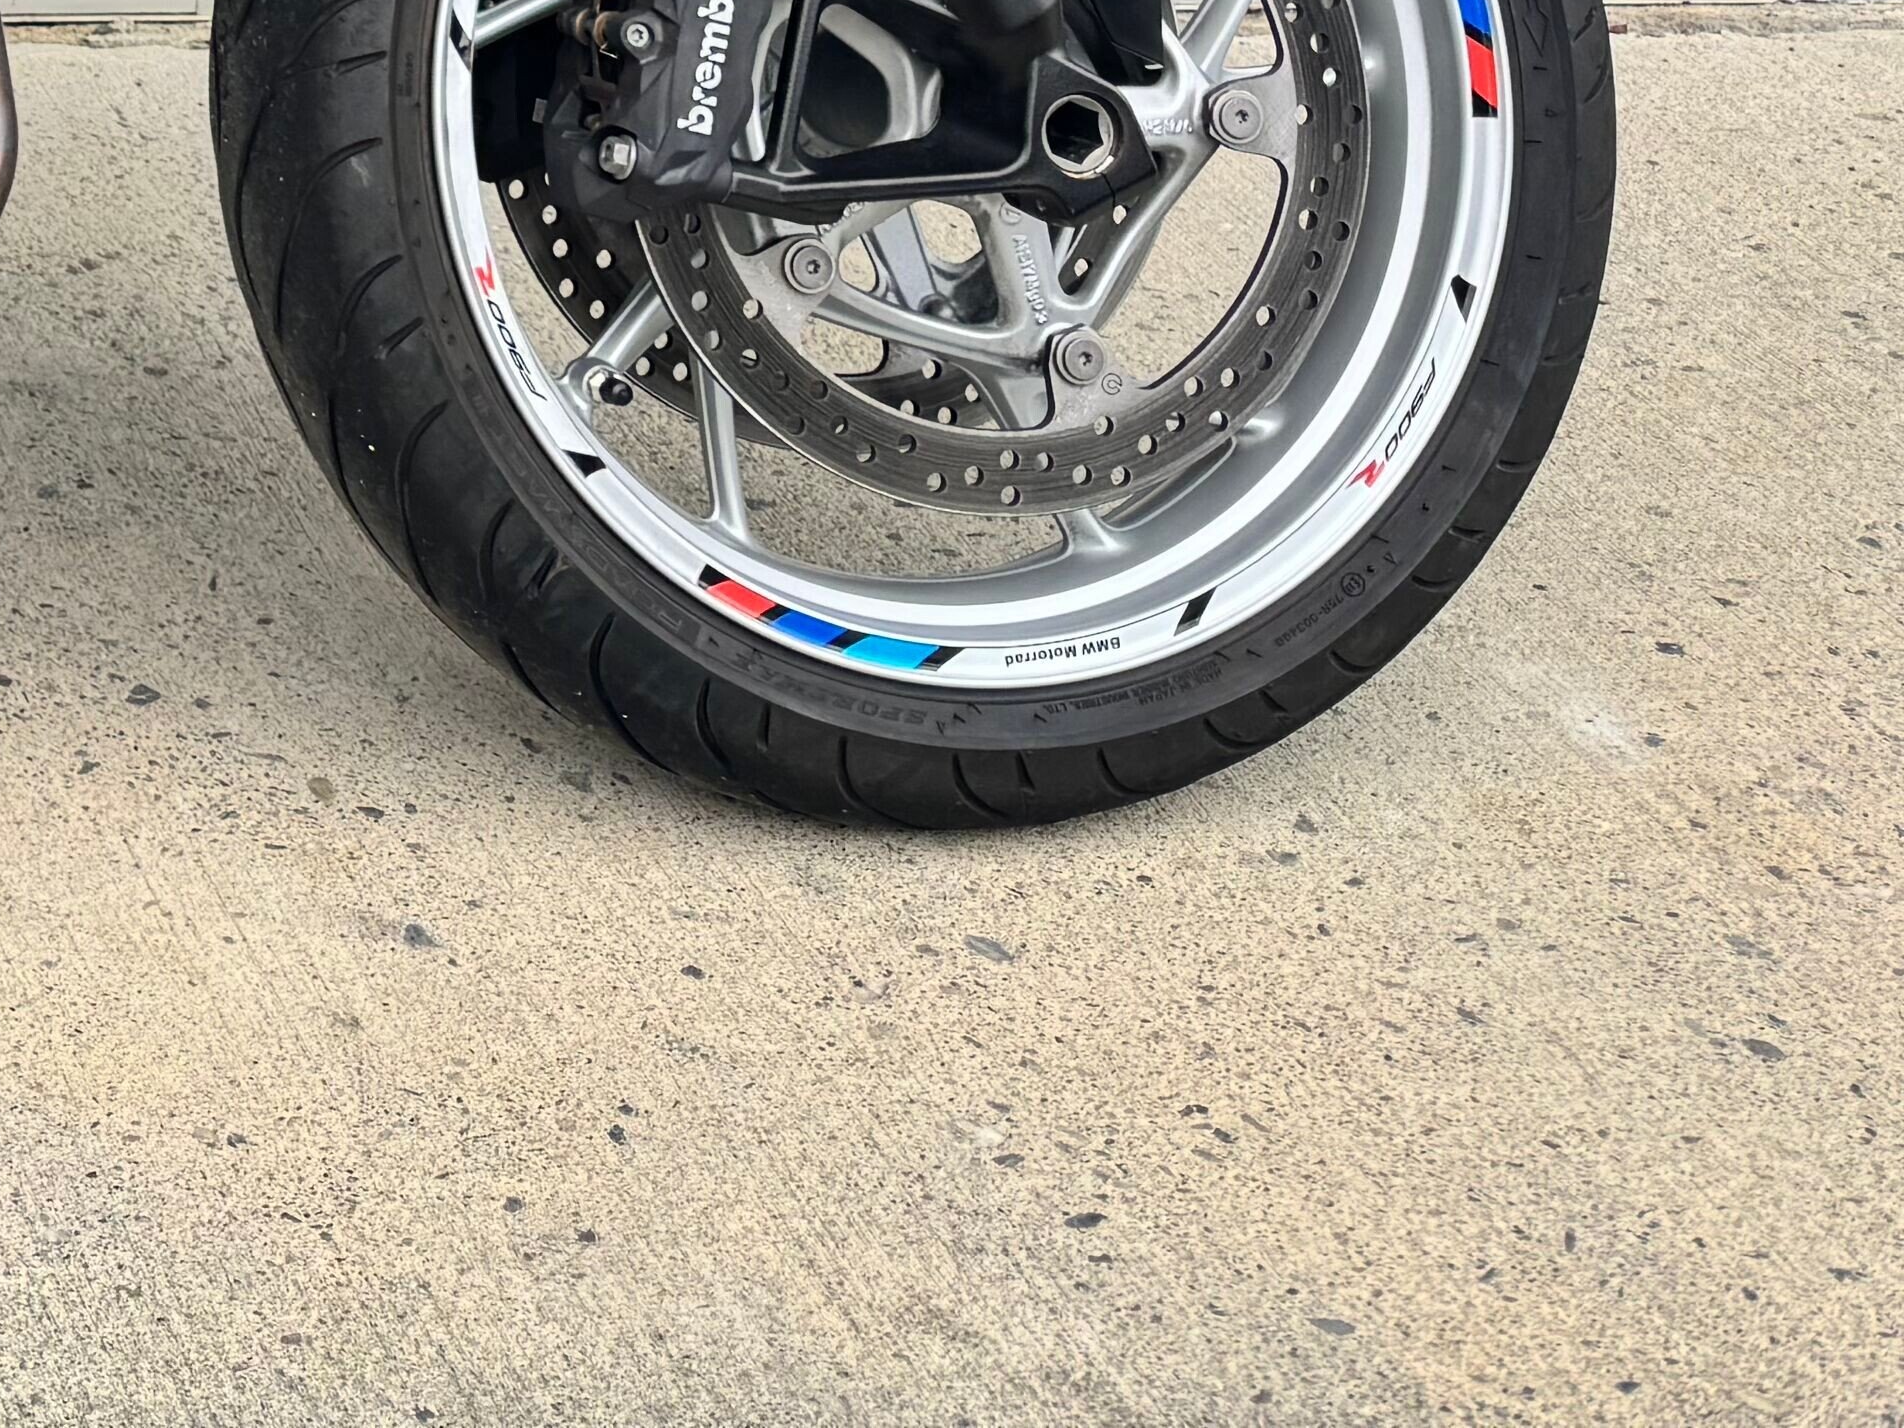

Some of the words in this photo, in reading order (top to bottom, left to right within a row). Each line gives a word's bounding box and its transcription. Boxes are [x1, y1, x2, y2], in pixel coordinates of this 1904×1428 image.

[474, 245, 548, 402] F900R
[1345, 356, 1437, 489] F900R
[1005, 644, 1077, 667] Motorrad
[1082, 637, 1122, 655] BMW
